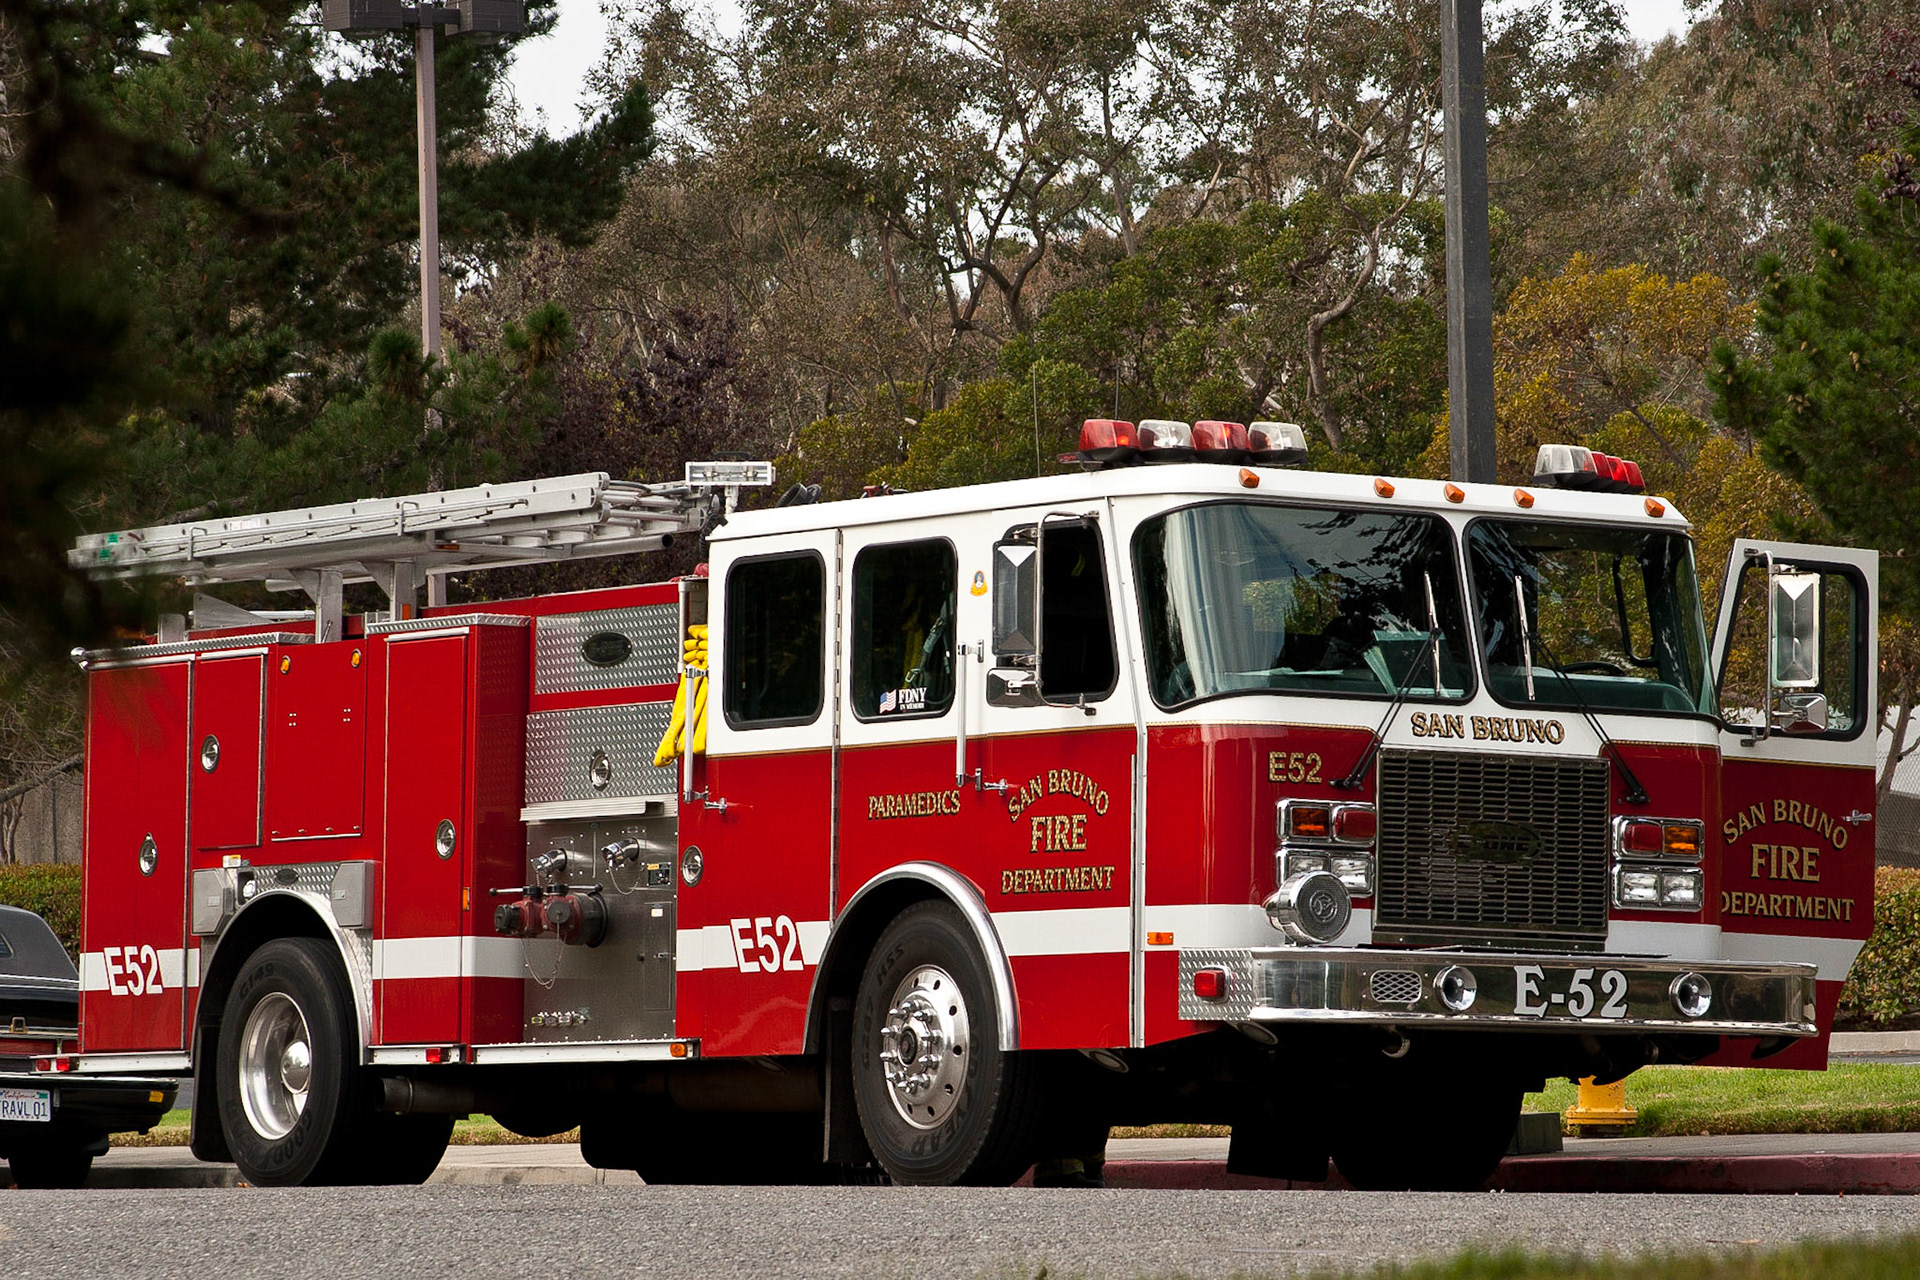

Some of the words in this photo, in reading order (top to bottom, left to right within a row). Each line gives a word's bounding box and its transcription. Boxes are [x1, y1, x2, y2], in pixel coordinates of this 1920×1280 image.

[898, 687, 927, 704] FDNY
[1411, 711, 1465, 739] SAN
[1471, 715, 1566, 745] BRUNO
[1268, 751, 1322, 784] E52
[868, 789, 961, 820] PARAMEDICS
[1007, 774, 1044, 822] SAN
[1047, 768, 1110, 817] BRUNO
[1029, 814, 1088, 854] FIRE
[1722, 802, 1766, 845] SAN
[1773, 799, 1848, 850] BRUNO
[1001, 866, 1115, 894] DEPARTMENT
[1750, 843, 1821, 882] FIRE
[730, 915, 804, 973] E52
[104, 944, 163, 996] E52
[875, 943, 905, 986] HSS
[1513, 964, 1628, 1018] E-52
[0, 1100, 30, 1116] RAVL
